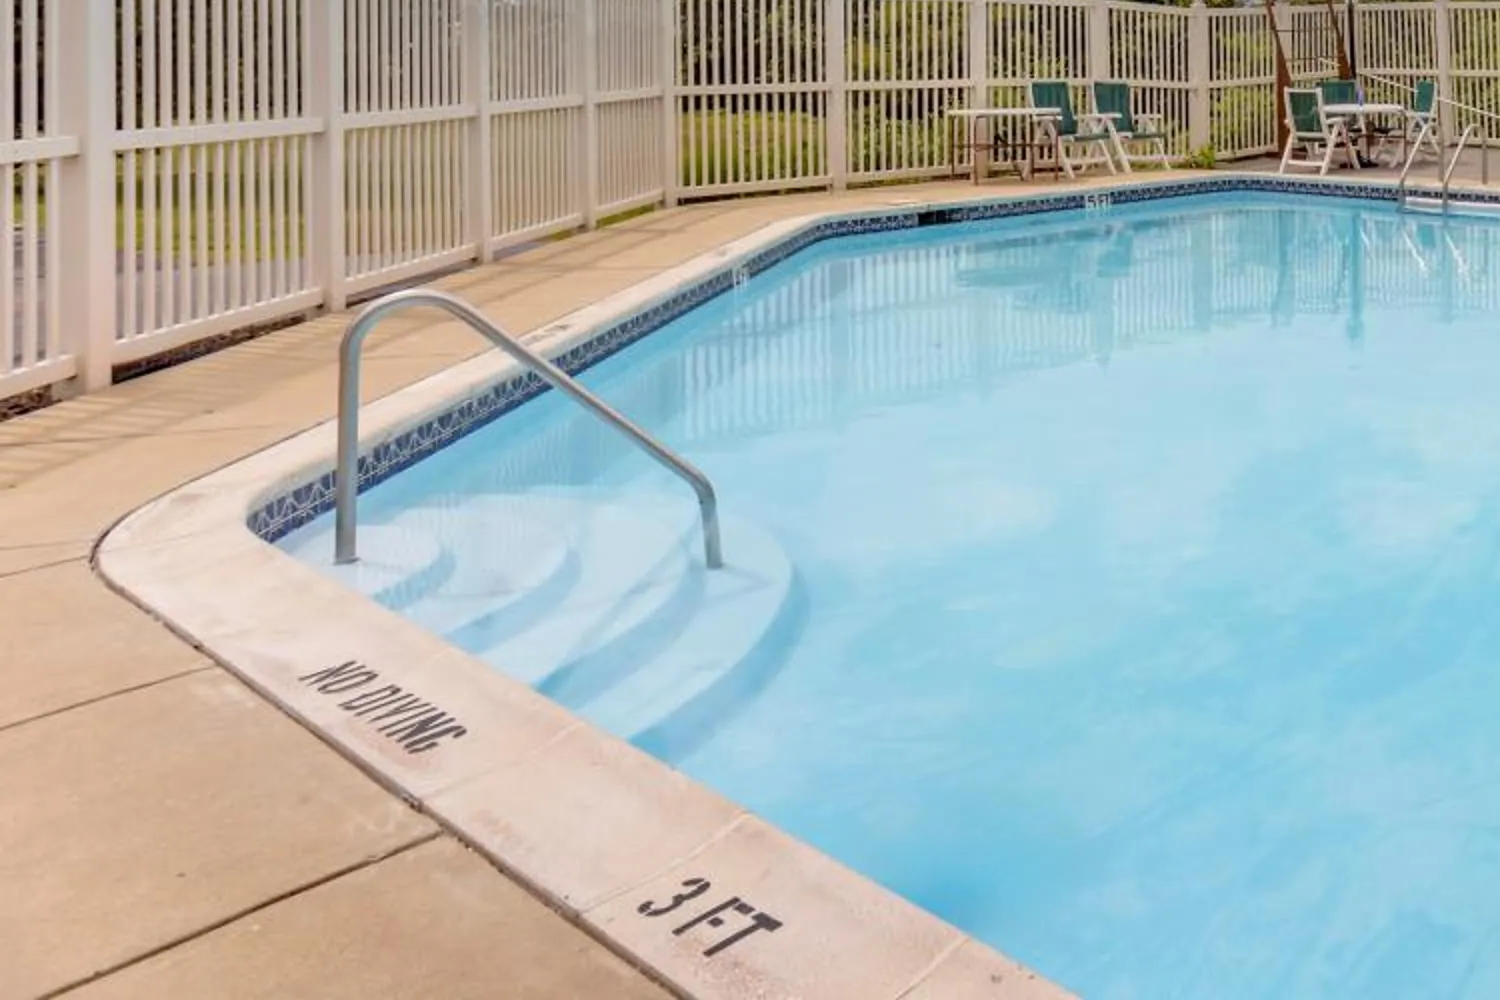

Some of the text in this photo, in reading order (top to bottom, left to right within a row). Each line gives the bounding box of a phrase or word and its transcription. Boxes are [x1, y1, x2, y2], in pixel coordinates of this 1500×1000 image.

[297, 659, 468, 755] NO DIVING
[636, 877, 784, 958] 3 FT
